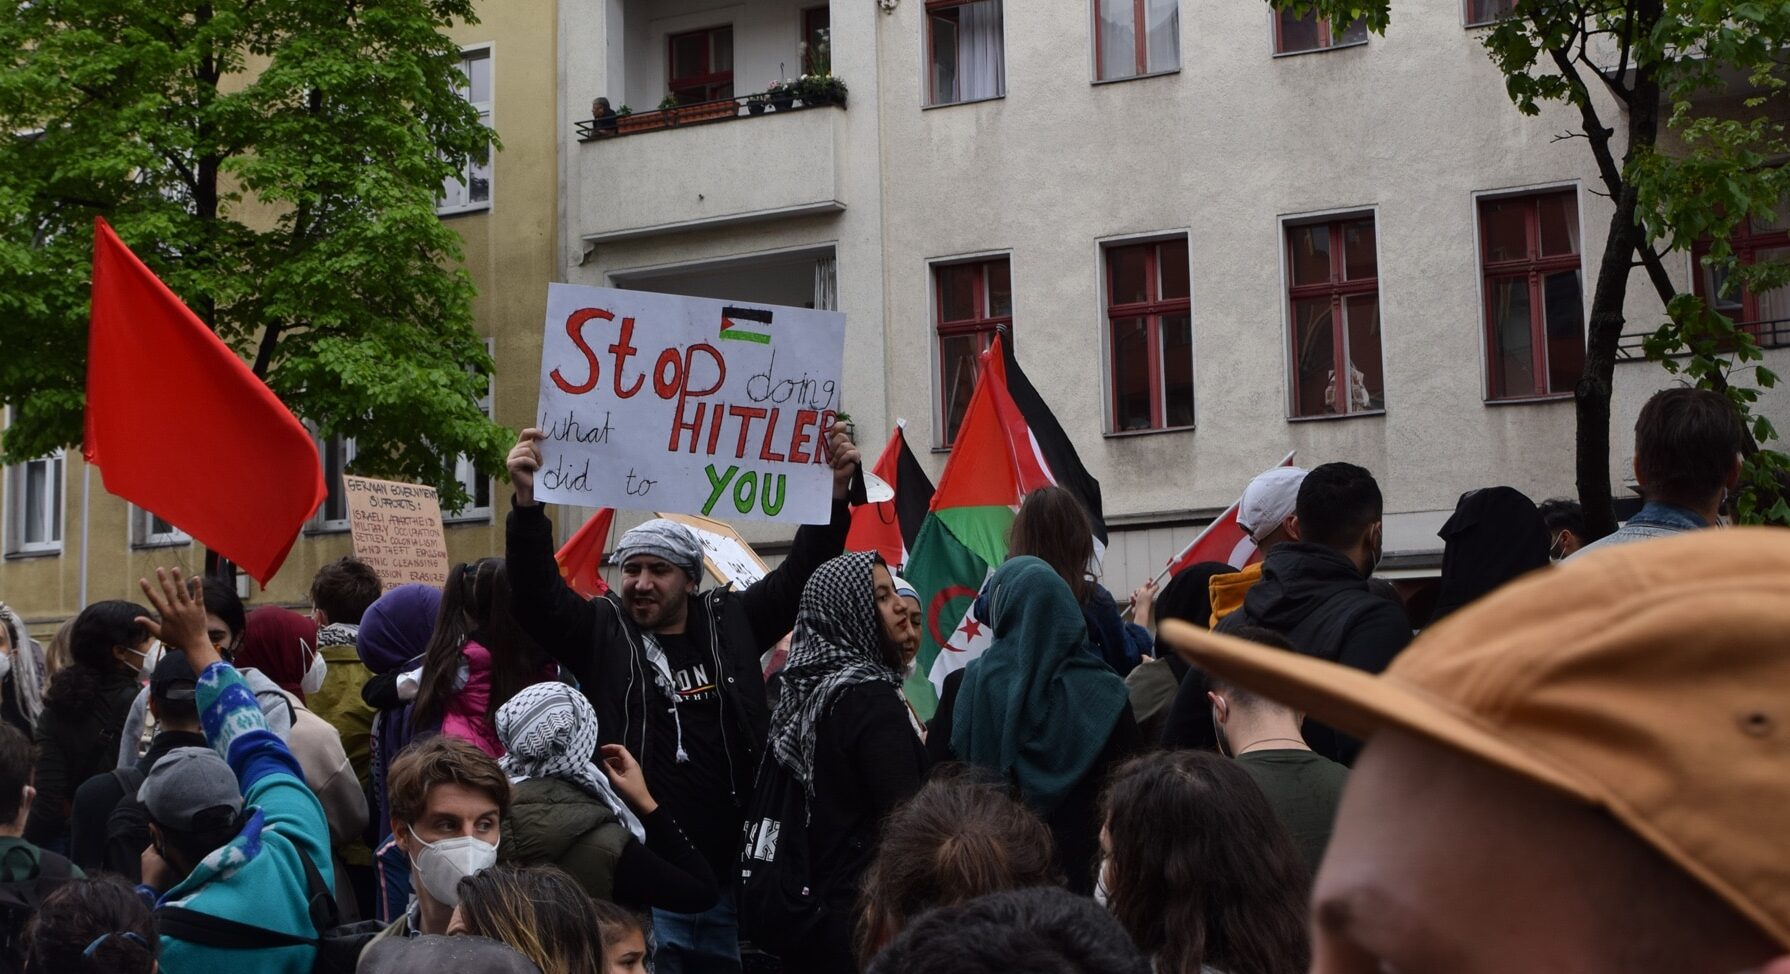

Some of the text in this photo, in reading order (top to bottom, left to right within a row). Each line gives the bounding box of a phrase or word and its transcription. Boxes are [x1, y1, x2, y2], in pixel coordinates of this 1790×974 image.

[549, 307, 836, 411] Stop doing
[541, 402, 839, 465] what HITLER
[348, 478, 438, 500] GERMAN GOVERNMENT
[543, 454, 786, 516] did to YOU
[352, 509, 435, 527] ISRAELI APARTHEID
[353, 521, 441, 538] MILITARY OCCUPATION
[354, 532, 438, 548] SETTLER COLONIALISM
[357, 543, 381, 554] LAND
[382, 545, 412, 555] THEFT
[392, 558, 438, 568] CLEANSING
[376, 569, 446, 583] ESSION ERASURE
